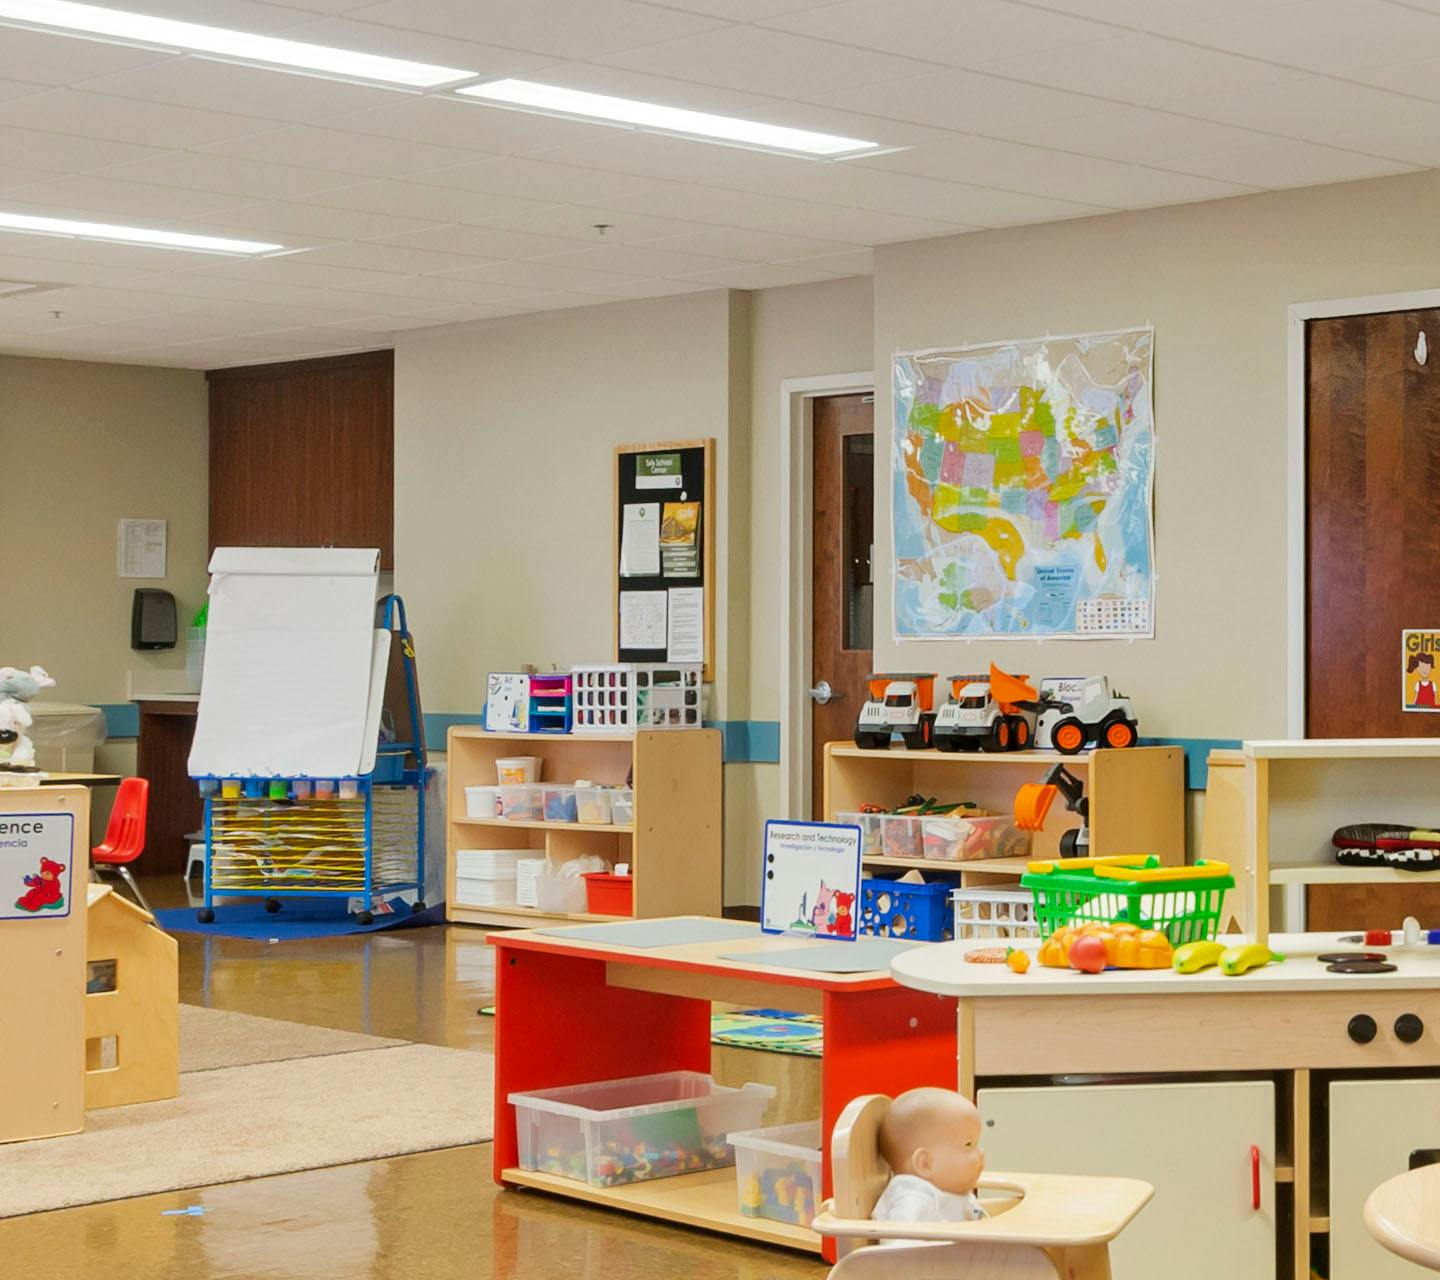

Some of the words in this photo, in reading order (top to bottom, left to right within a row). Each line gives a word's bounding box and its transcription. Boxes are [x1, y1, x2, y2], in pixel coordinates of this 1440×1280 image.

[770, 831, 800, 841] Research
[802, 833, 815, 842] and
[817, 833, 857, 846] Technology
